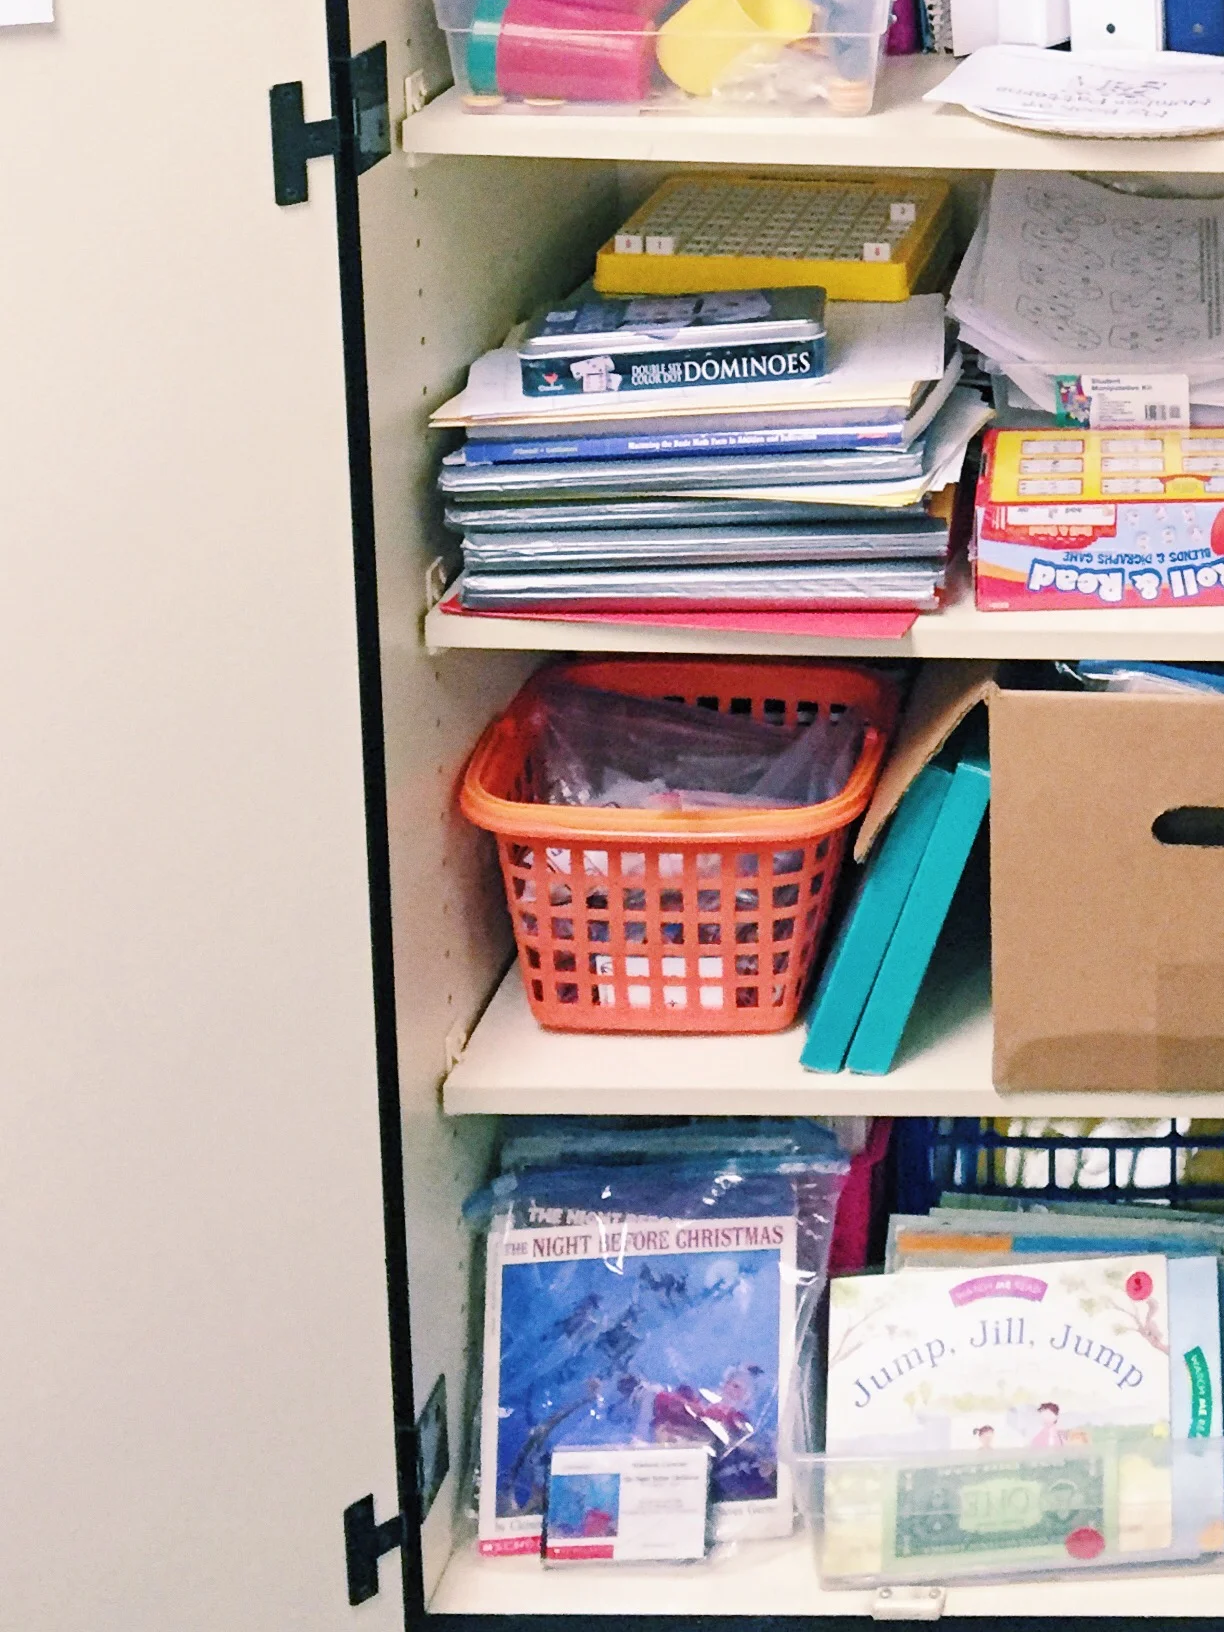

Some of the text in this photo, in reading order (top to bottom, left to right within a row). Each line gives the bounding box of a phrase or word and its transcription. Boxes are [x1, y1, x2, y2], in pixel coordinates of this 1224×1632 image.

[684, 351, 811, 384] DOMINOES
[1062, 549, 1096, 563] GAME
[1098, 551, 1153, 566] DIGRAPHS
[1168, 548, 1212, 562] BLENDS
[1026, 558, 1126, 603] Read
[1129, 566, 1164, 601] &
[505, 1225, 785, 1258] THE NIGHT BEFORE CHRISTMAS
[852, 1317, 1146, 1409] Jump, Jill, Jump
